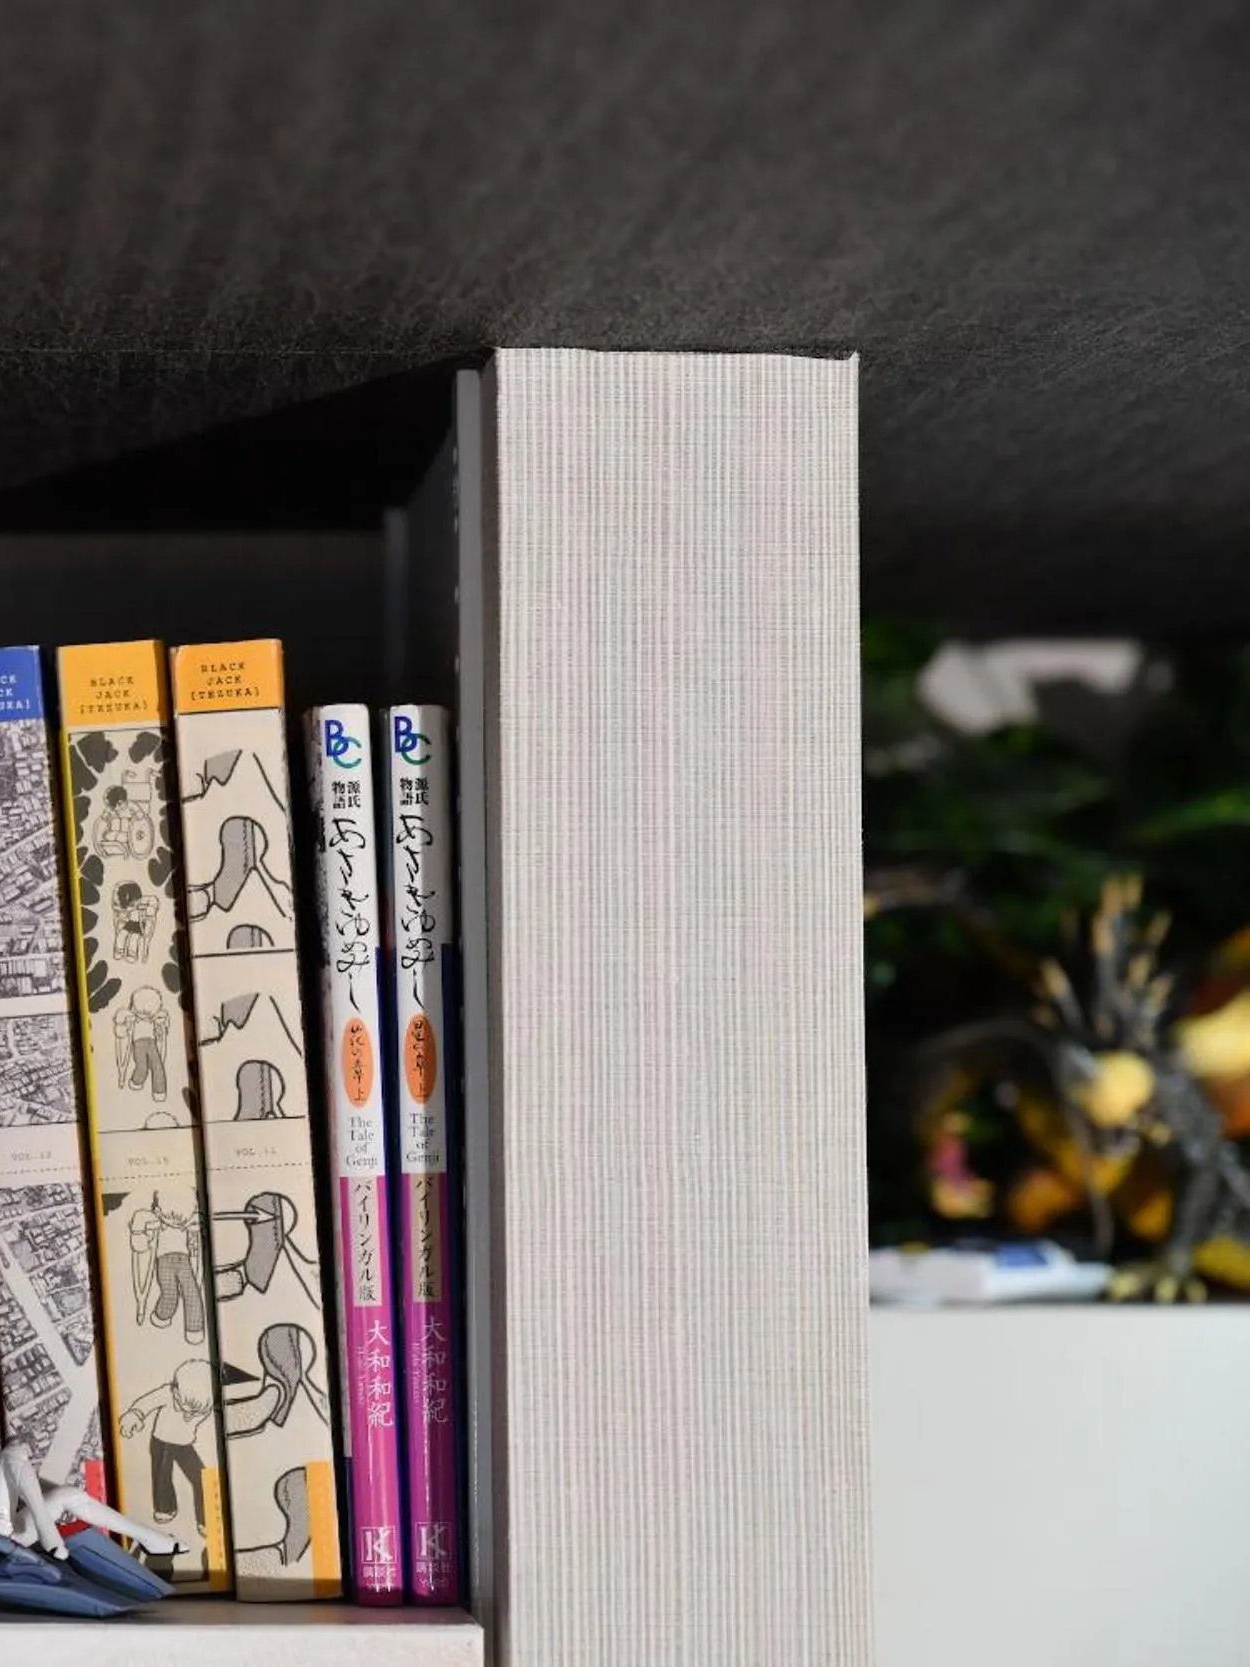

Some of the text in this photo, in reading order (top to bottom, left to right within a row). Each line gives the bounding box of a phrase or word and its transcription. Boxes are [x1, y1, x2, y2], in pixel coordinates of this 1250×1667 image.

[90, 676, 134, 687] BLACK
[95, 688, 131, 699] JACK
[200, 662, 246, 673] BLACK
[206, 675, 242, 685] JACK
[355, 1180, 376, 1302] バイリンガル版
[415, 1176, 438, 1299] バイリンガル版
[366, 1320, 395, 1427] 大和和紀
[420, 1316, 448, 1423] 大和和紀
